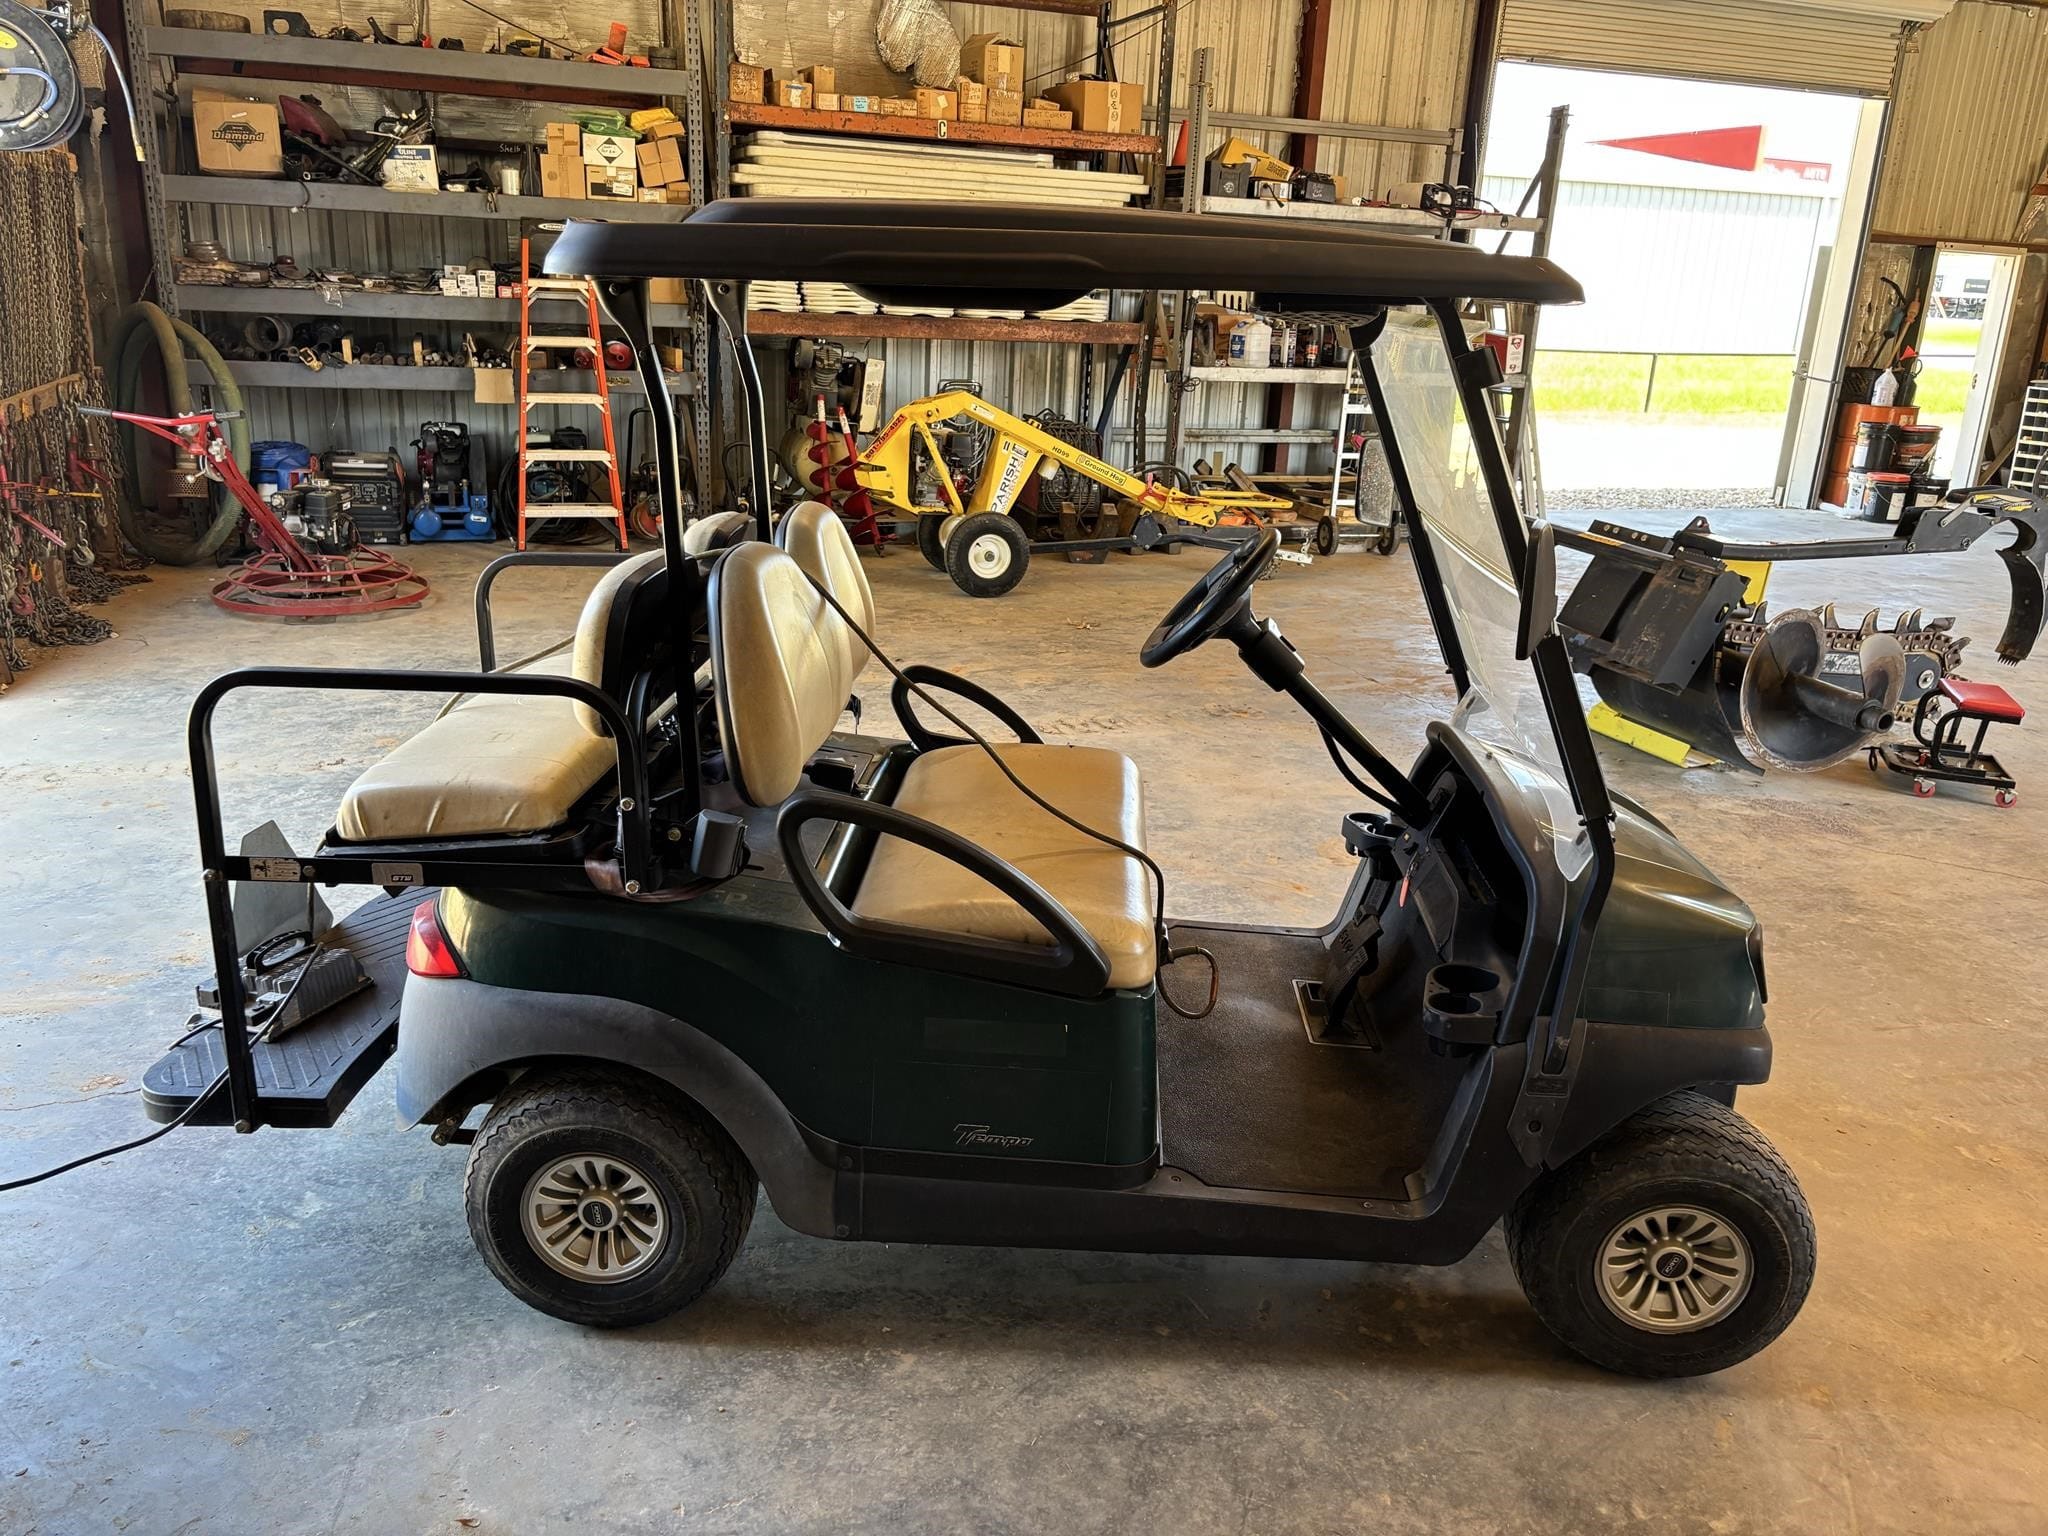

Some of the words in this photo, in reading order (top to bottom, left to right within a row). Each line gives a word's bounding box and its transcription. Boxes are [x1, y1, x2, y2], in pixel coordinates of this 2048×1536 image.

[212, 130, 264, 141] Diamond
[938, 121, 946, 138] C
[1052, 445, 1070, 458] HD99
[1084, 460, 1110, 476] Ground
[1110, 472, 1124, 484] Hog
[990, 456, 1020, 513] PARISH
[953, 1123, 1035, 1148] Tempo
